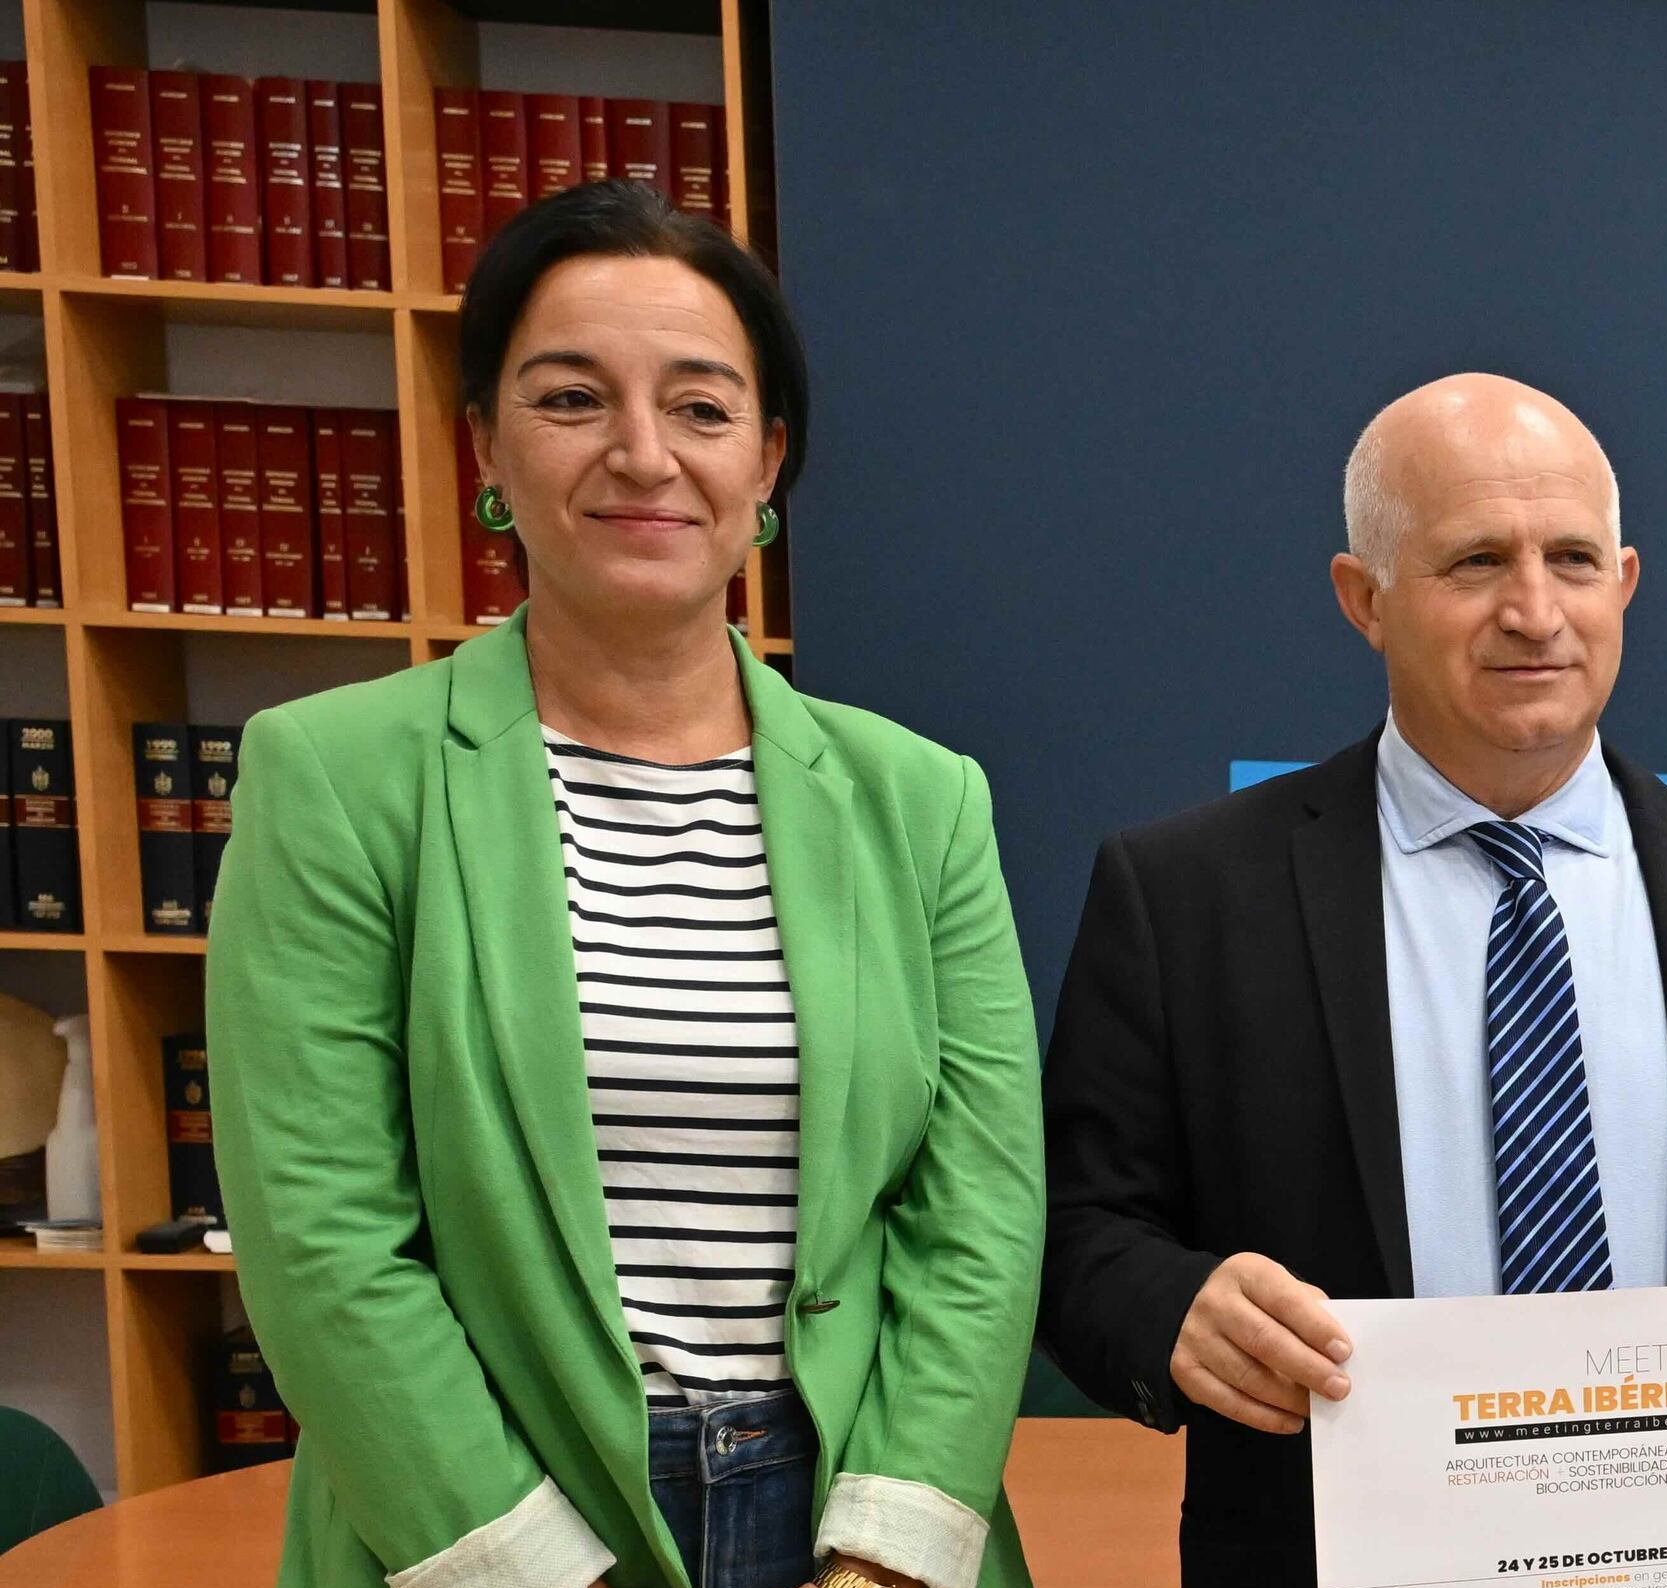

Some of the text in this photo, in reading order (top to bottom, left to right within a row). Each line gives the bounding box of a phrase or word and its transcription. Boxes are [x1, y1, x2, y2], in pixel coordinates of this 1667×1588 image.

[1453, 1388, 1575, 1421] TERRA
[1446, 1454, 1548, 1471] ARQUITECTURA
[1448, 1467, 1549, 1486] RESTAURACIÓN
[1537, 1472, 1667, 1494] BIOCONSTRUCCIÓN
[1498, 1560, 1519, 1572] 24
[1523, 1558, 1534, 1570] Y
[1539, 1556, 1558, 1569] 25
[1563, 1554, 1584, 1567] DE
[1588, 1547, 1667, 1565] OCTUBRE
[1542, 1574, 1630, 1588] Inscripciones
[1634, 1573, 1649, 1581] en
